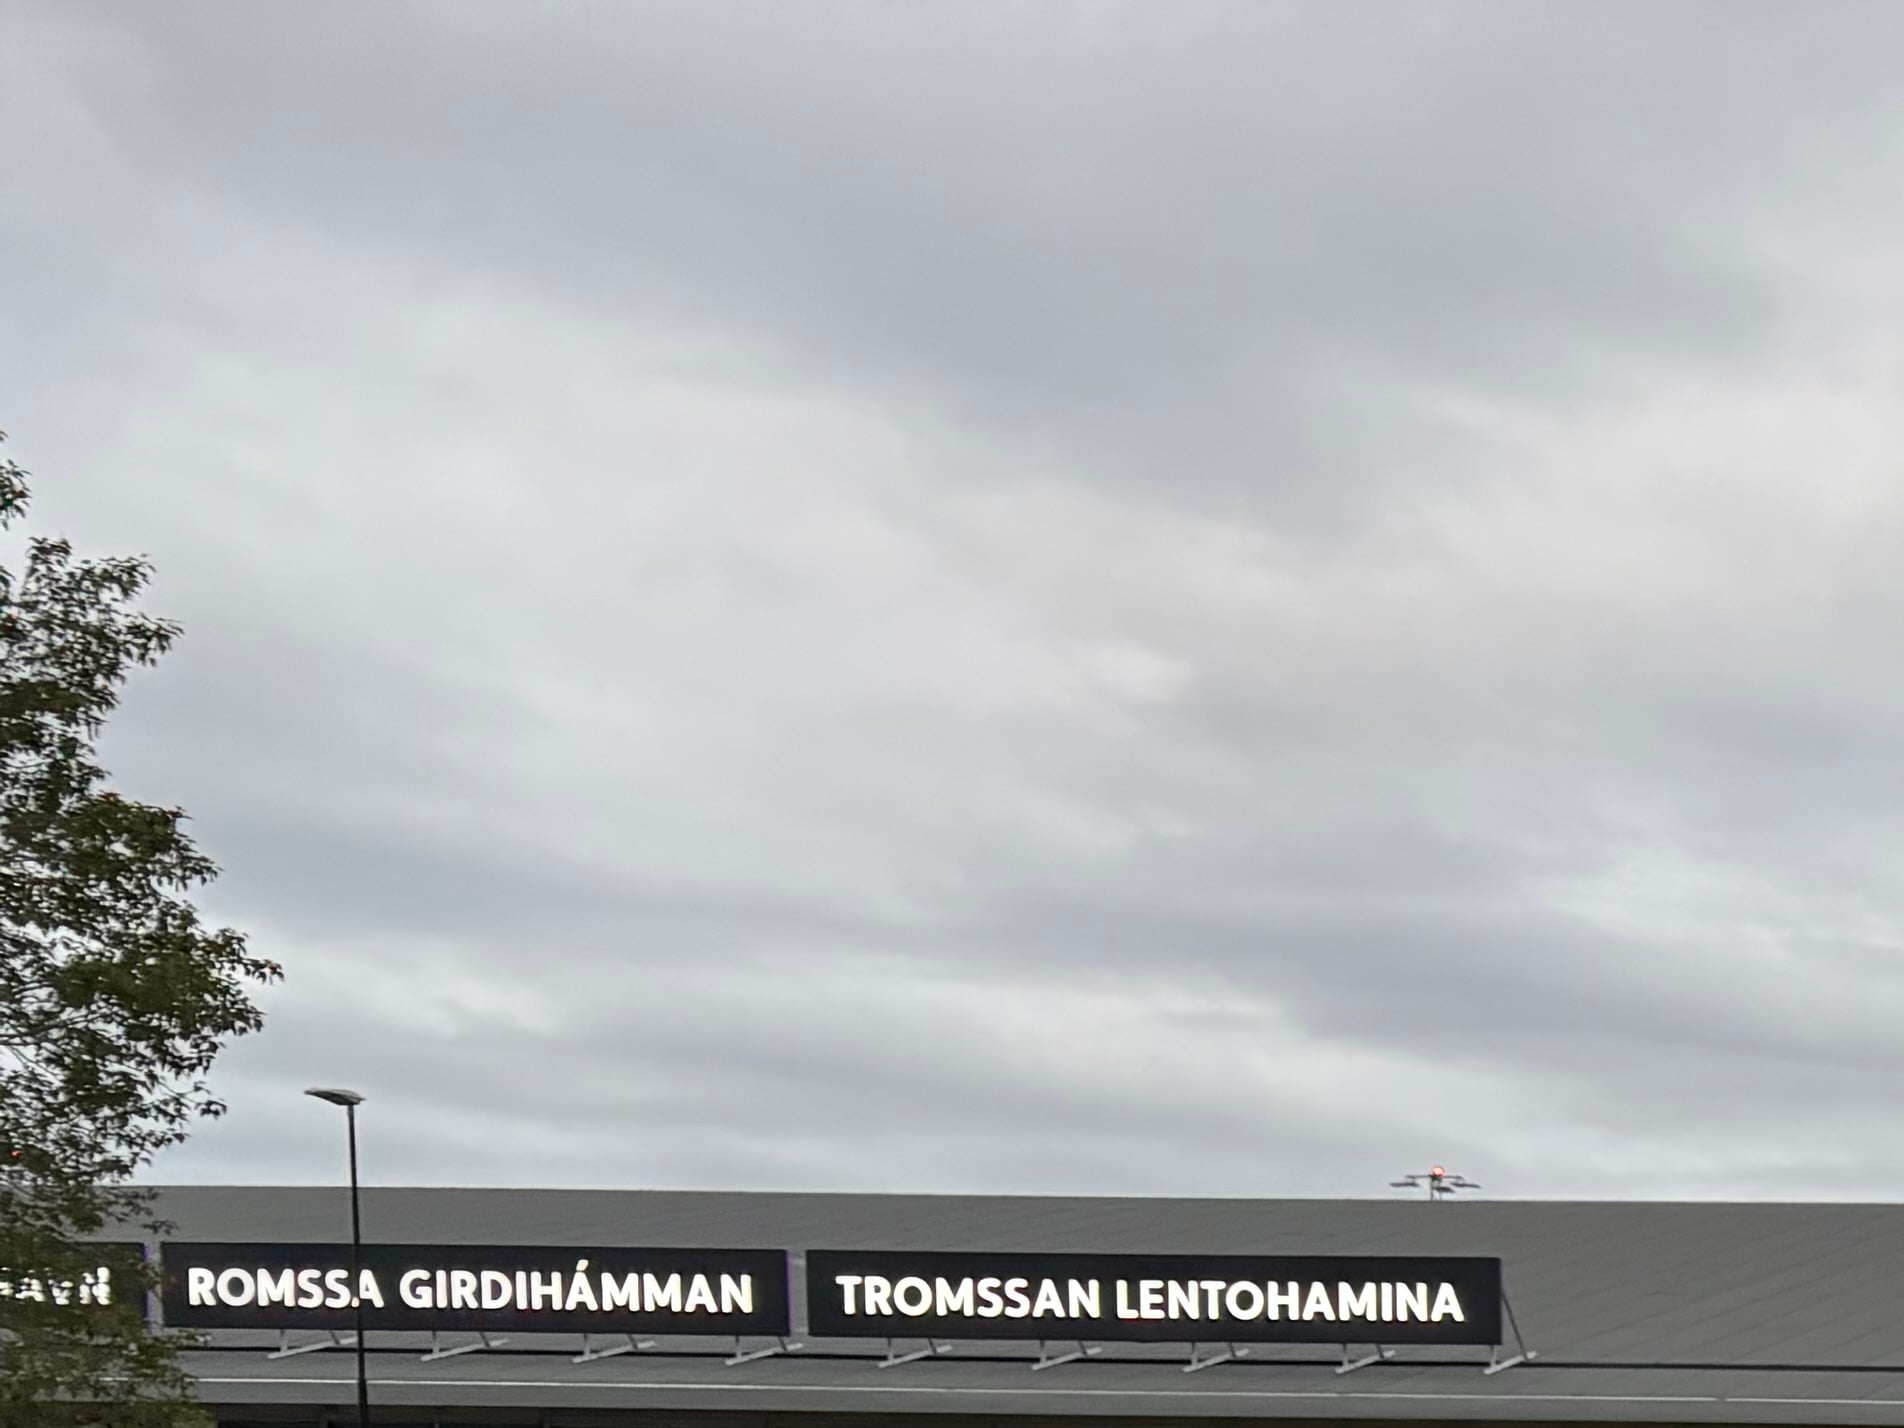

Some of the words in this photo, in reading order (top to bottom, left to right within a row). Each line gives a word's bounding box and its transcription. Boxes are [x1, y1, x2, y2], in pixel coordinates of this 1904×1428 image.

[188, 1267, 385, 1309] ROMSSA
[399, 1260, 753, 1314] GIRDIHÁMMAN
[835, 1275, 1101, 1319] TROMSSAN
[1116, 1279, 1465, 1322] LENTOHAMINA
